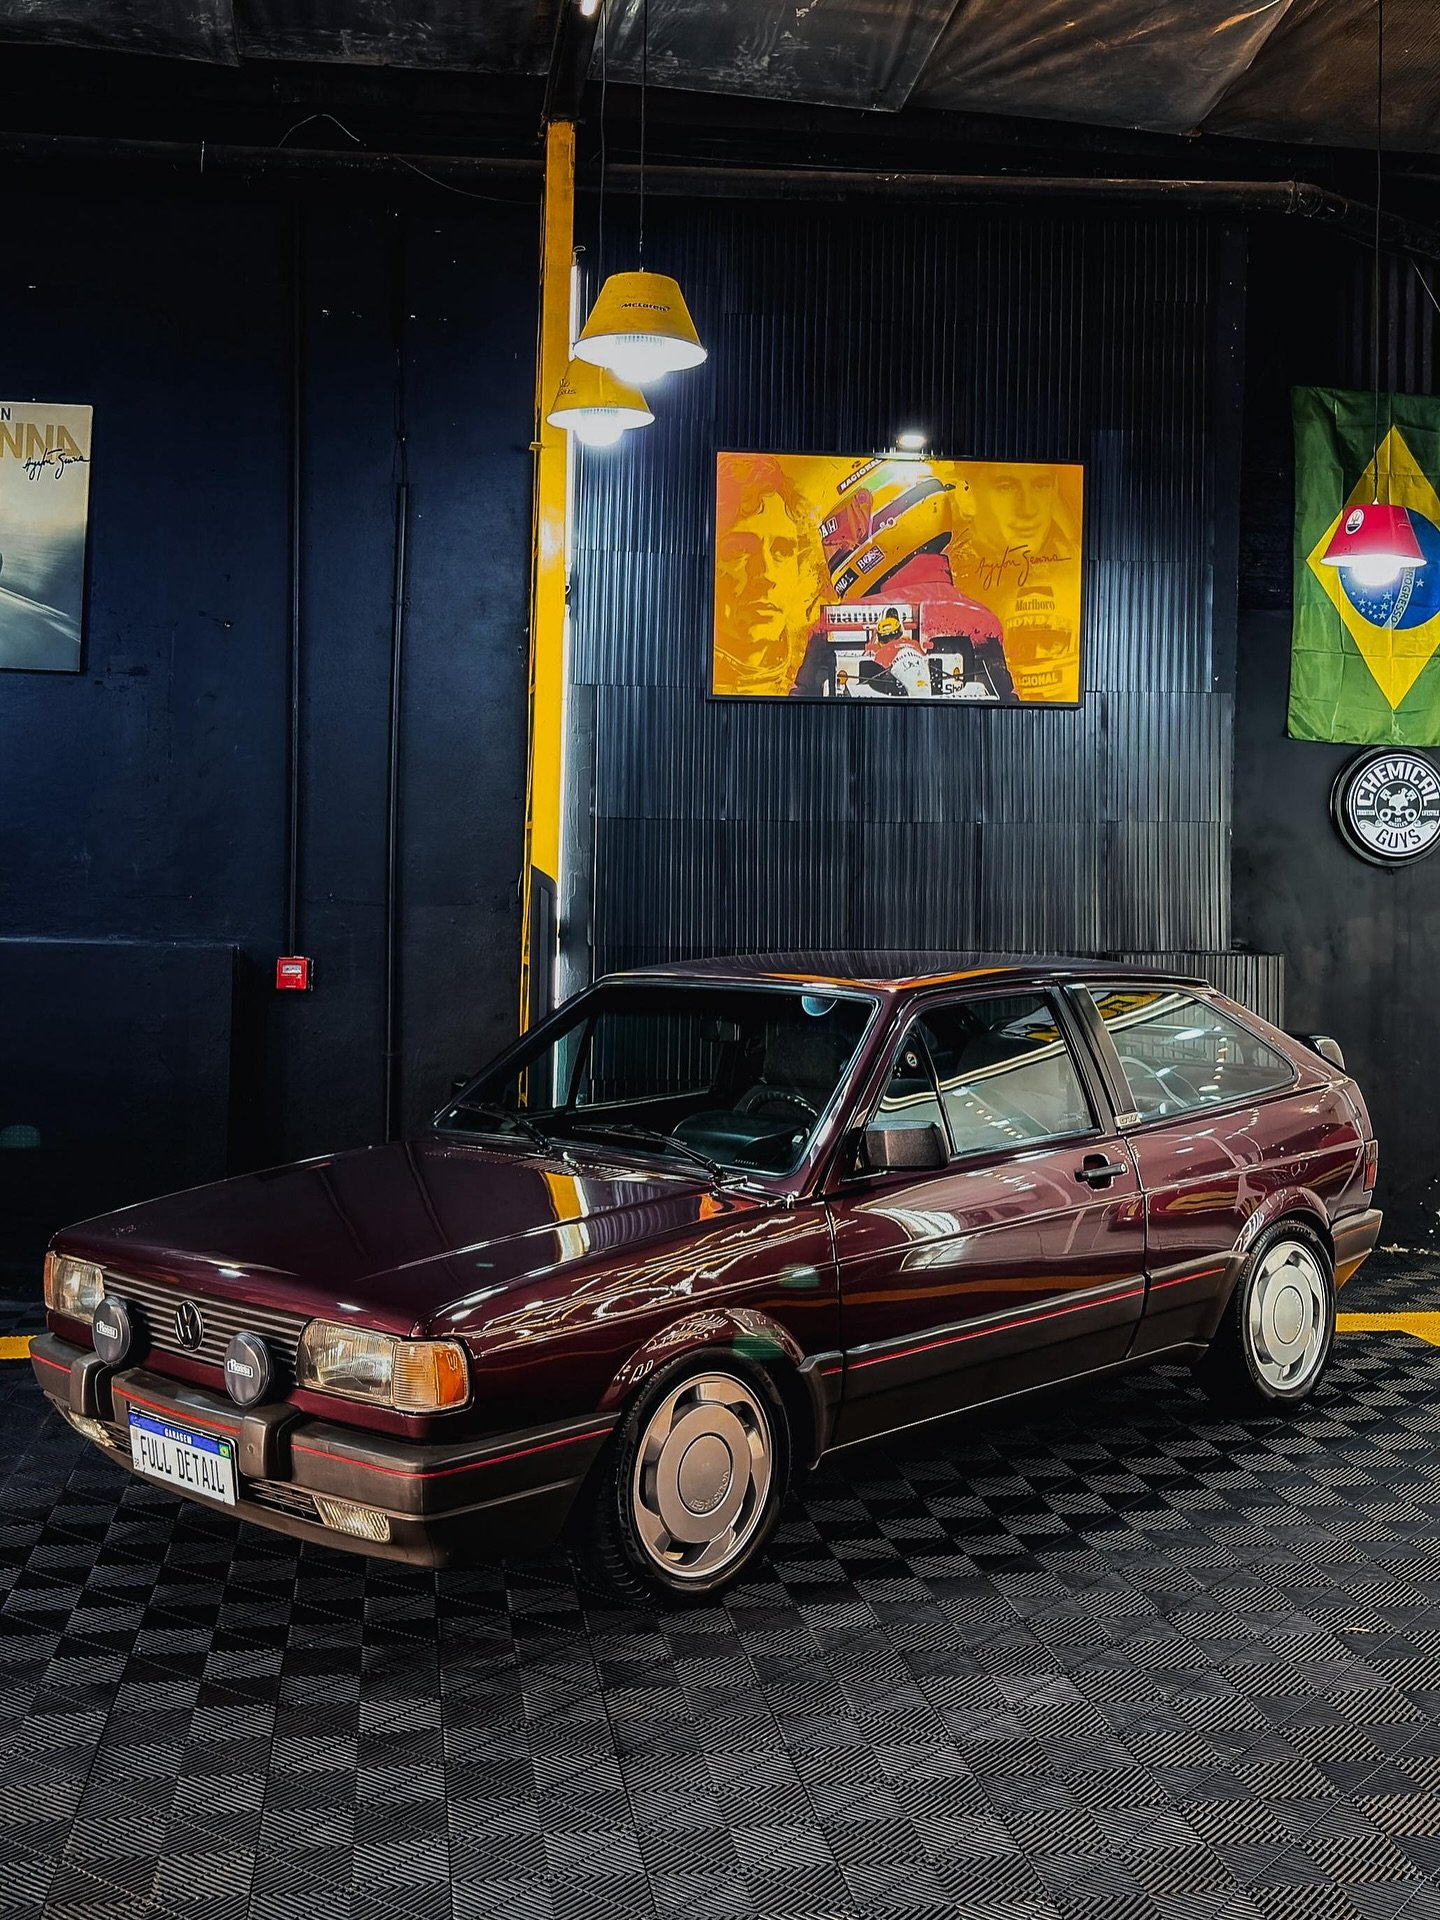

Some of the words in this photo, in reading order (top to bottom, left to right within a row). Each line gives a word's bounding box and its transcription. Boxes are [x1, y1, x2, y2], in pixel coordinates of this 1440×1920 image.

[1014, 599, 1055, 612] Marlboro
[1357, 762, 1440, 806] CHEMICAL
[1375, 828, 1421, 849] GUYS
[164, 1427, 193, 1445] GARAGEM
[140, 1435, 172, 1475] FULL
[176, 1447, 225, 1494] DETAIL
